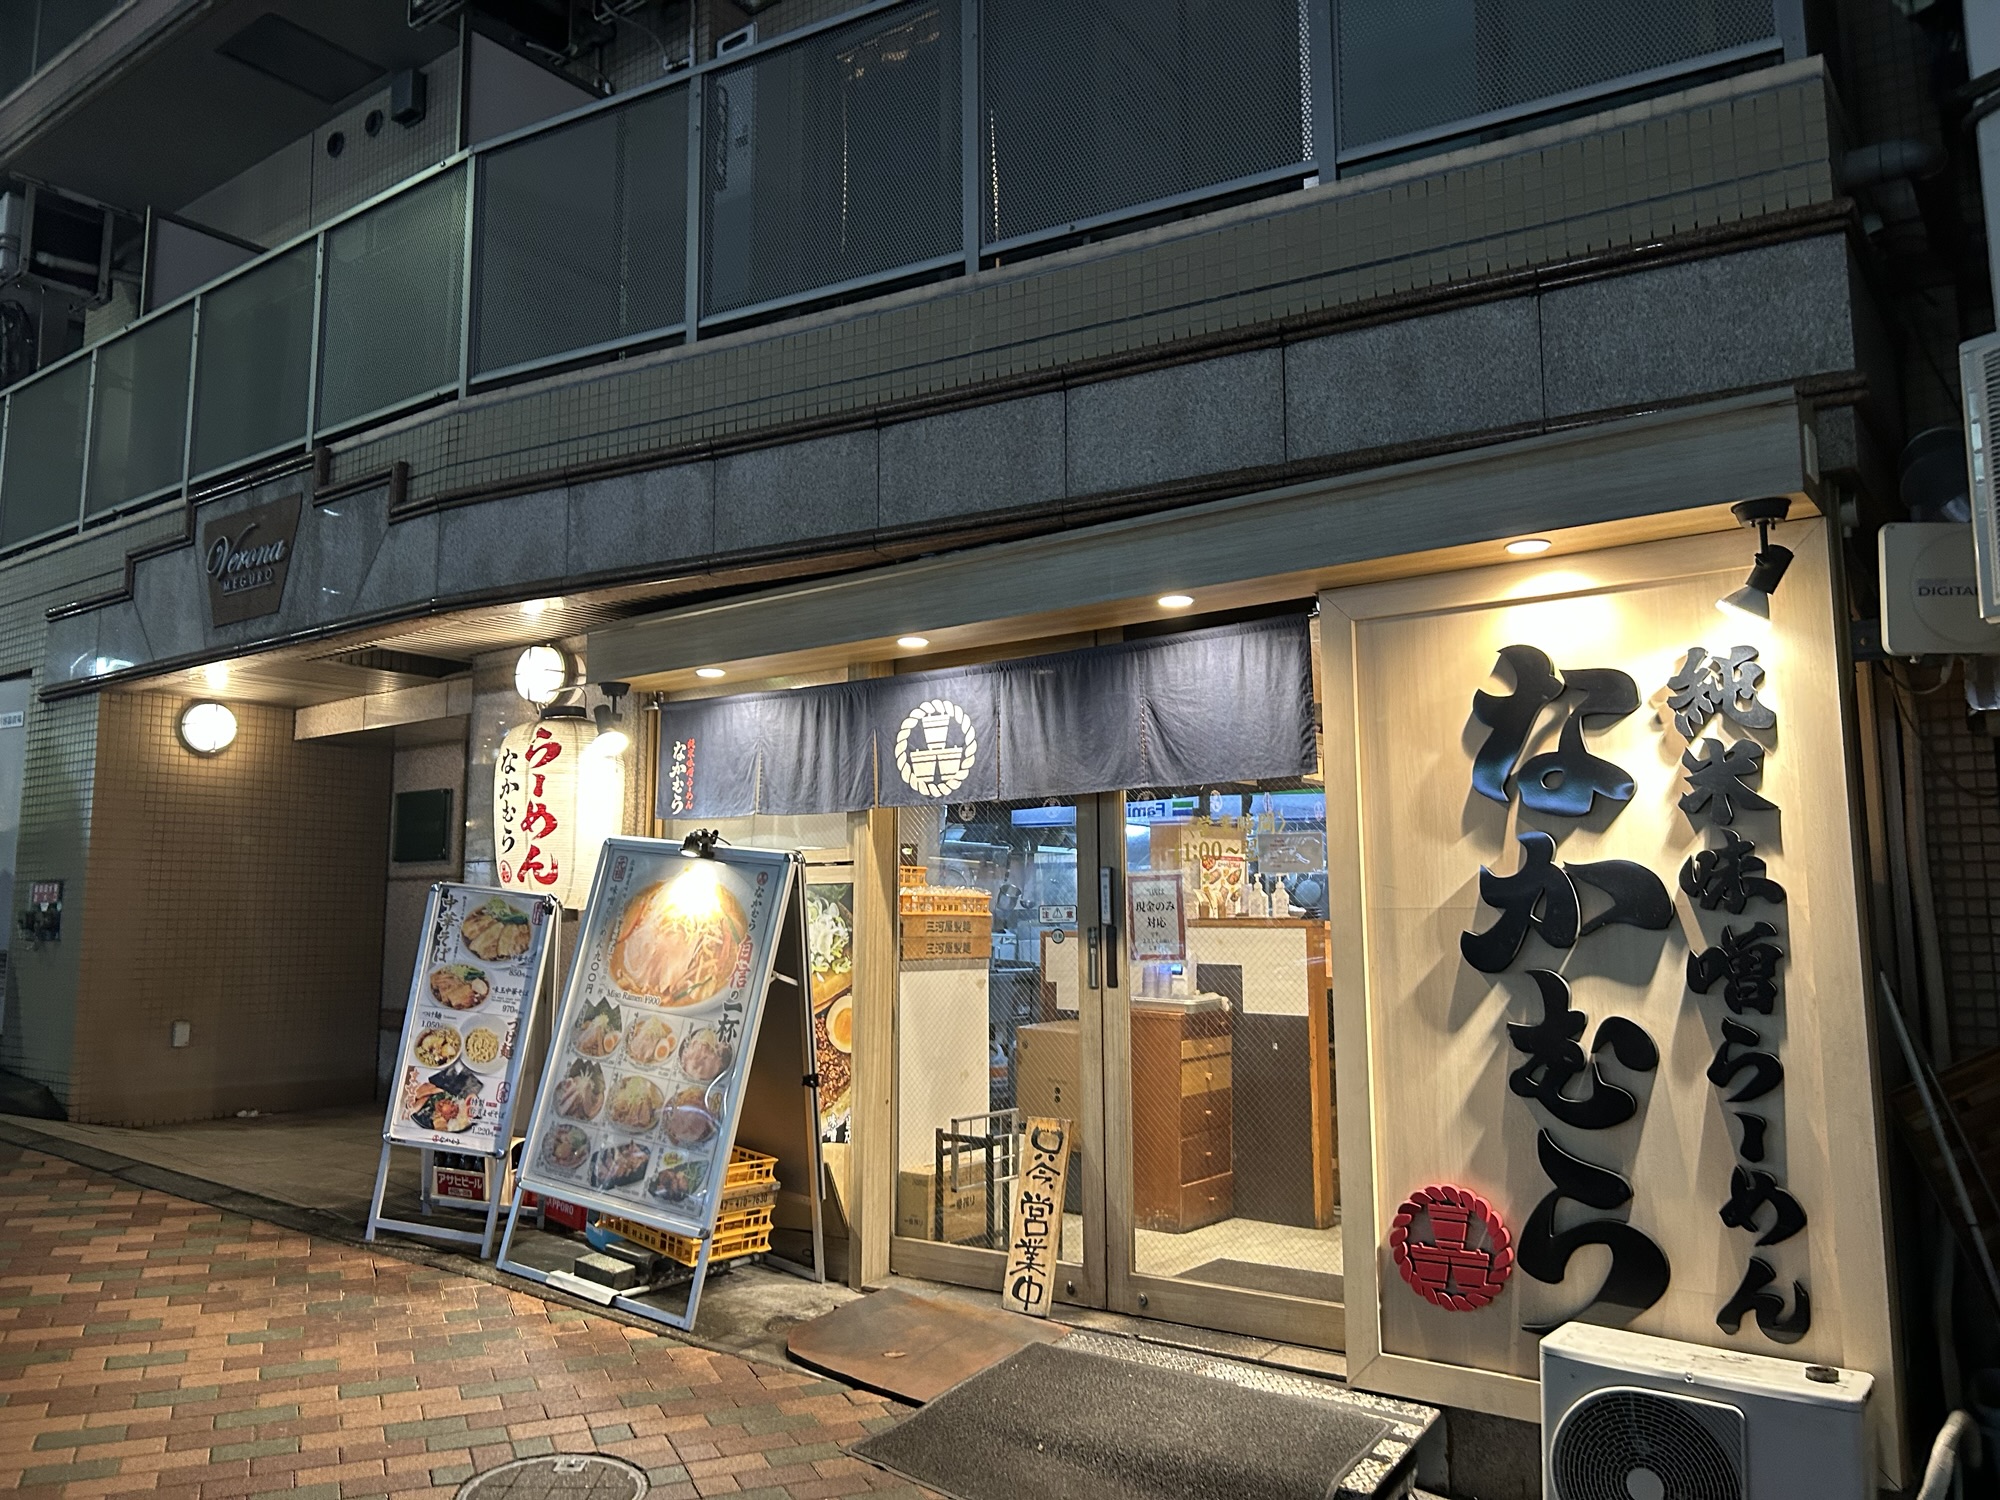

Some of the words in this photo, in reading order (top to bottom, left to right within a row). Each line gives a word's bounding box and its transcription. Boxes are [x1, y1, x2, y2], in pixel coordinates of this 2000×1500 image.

[206, 522, 286, 579] Verona
[223, 567, 273, 592] MEGURO
[499, 748, 520, 855] なかむら
[517, 727, 562, 885] らーめん
[669, 741, 687, 815] なかむら
[433, 893, 459, 963] 中華そば
[748, 886, 766, 931] なかむら
[926, 921, 972, 934] 三河屋製麺
[1135, 900, 1176, 913] 現金のみ
[1146, 916, 1167, 928] 対応
[926, 942, 972, 955] 三河屋製麺
[607, 988, 622, 998] Miso
[622, 991, 643, 1003] Ramen
[643, 994, 662, 1006] ¥900
[716, 935, 754, 1044] 自信の一杯
[1460, 643, 1675, 1335] なかむら
[1667, 645, 1809, 1344] 純米味噌らーめん
[437, 1173, 483, 1190] アサヒビール
[1009, 1126, 1064, 1311] 只今営業中
